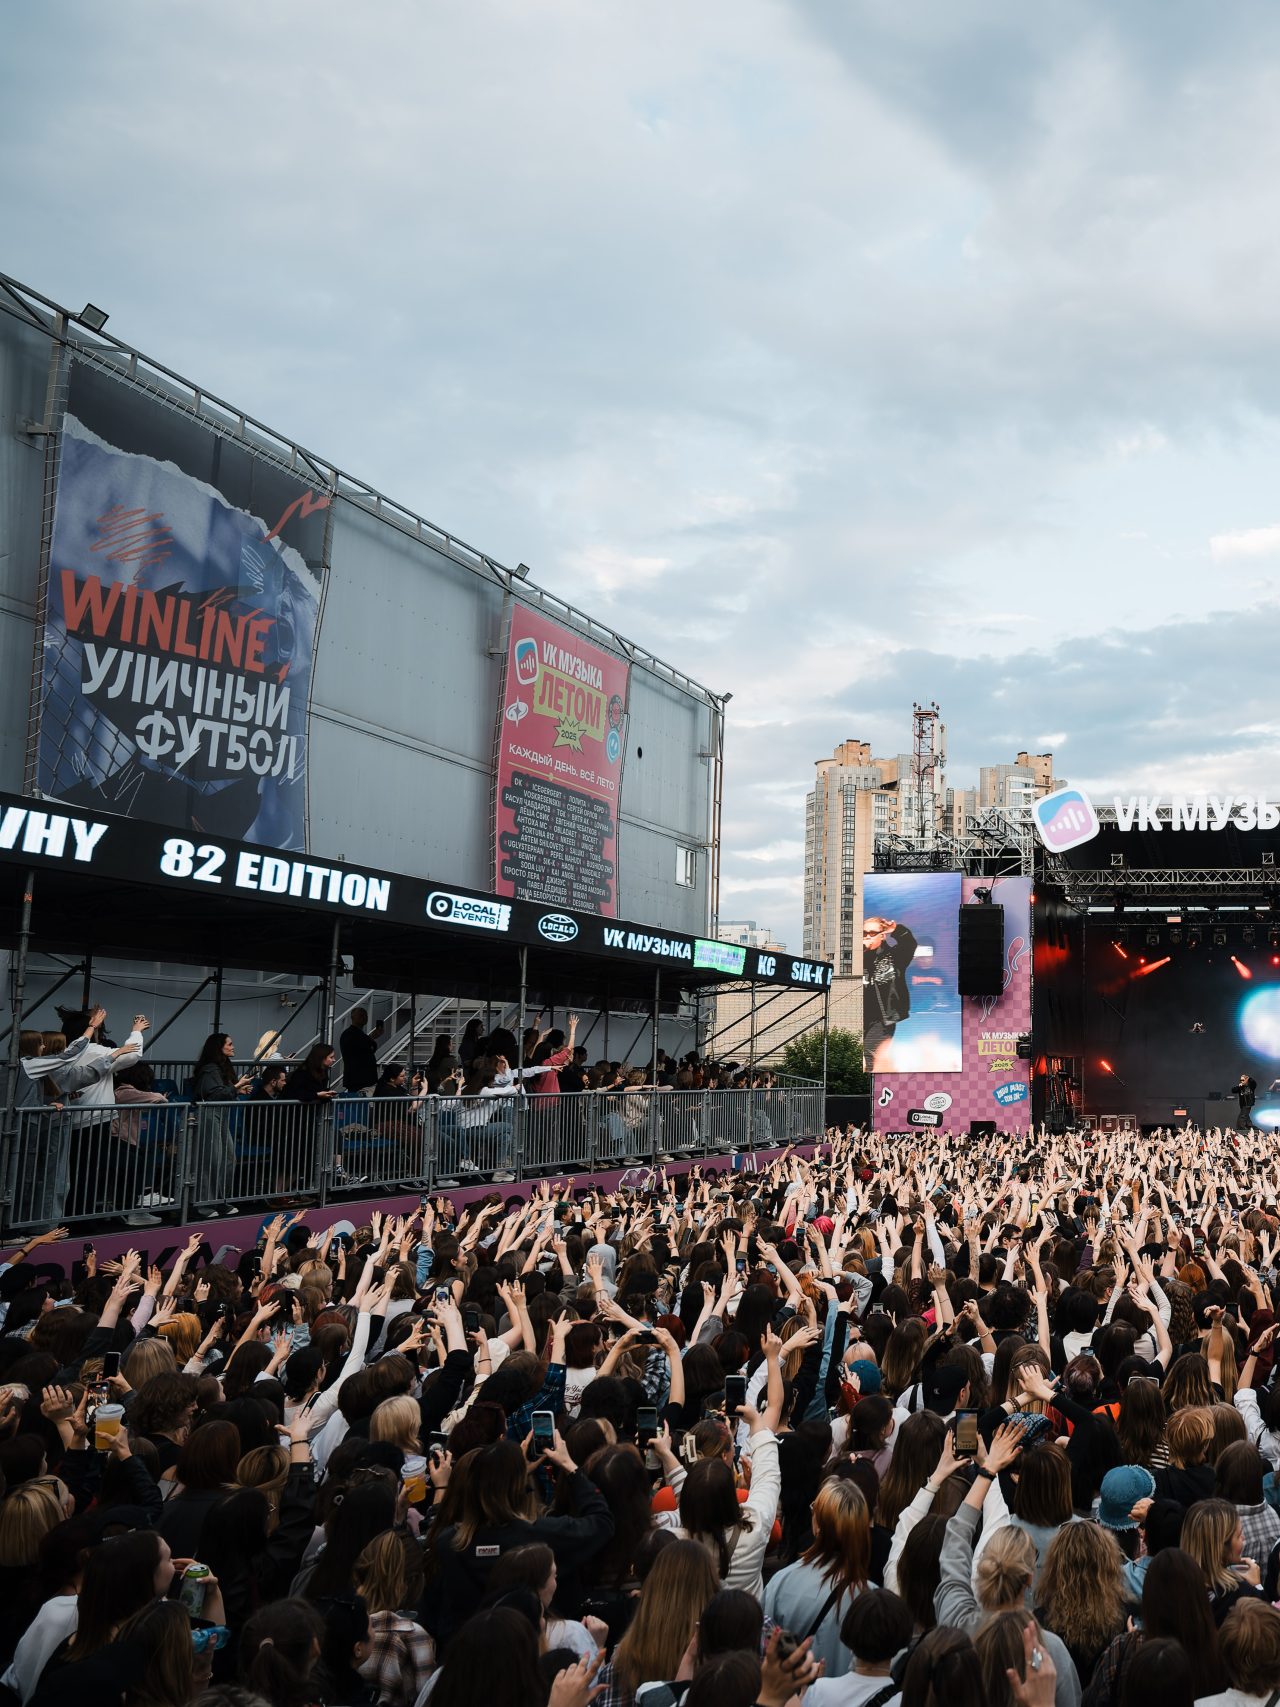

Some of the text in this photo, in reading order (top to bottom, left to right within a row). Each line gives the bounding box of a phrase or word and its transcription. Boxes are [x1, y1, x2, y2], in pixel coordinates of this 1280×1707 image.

[61, 569, 277, 675] WINLINE
[543, 640, 603, 691] VK МУЗЫКА
[538, 671, 602, 731] ЛЕТОМ
[560, 729, 577, 741] 2025
[135, 710, 297, 780] ФУТБОЛ
[509, 743, 615, 791] КАЖДЫЙ ДЕНЬ. ВСЁ ЛЕТО
[505, 793, 523, 804] РАСУЛ
[516, 815, 540, 827] АНТОХА
[1113, 796, 1163, 832] VK
[520, 834, 539, 844] ARTEM
[507, 840, 545, 855] UGLYSTEPHAN
[518, 852, 537, 862] BEWHY
[520, 861, 535, 870] SODA
[160, 838, 227, 884] 82
[235, 851, 392, 912] EDITION
[504, 867, 527, 877] ПРОСТО
[526, 872, 541, 880] ЛЕРА
[526, 881, 544, 890] ПАВЕЛ
[517, 888, 533, 897] ТИМА
[533, 891, 567, 904] БЕЛОРУССКИХ
[454, 901, 497, 916] LOCAL
[453, 910, 496, 925] EVENTS
[541, 921, 575, 934] LOCALS
[603, 927, 624, 949] VK
[627, 933, 692, 960] МУЗЫКА
[757, 954, 777, 976] KC
[791, 961, 824, 985] SIK-K
[981, 1031, 991, 1040] VK
[981, 1041, 1016, 1053] ЛЕТО
